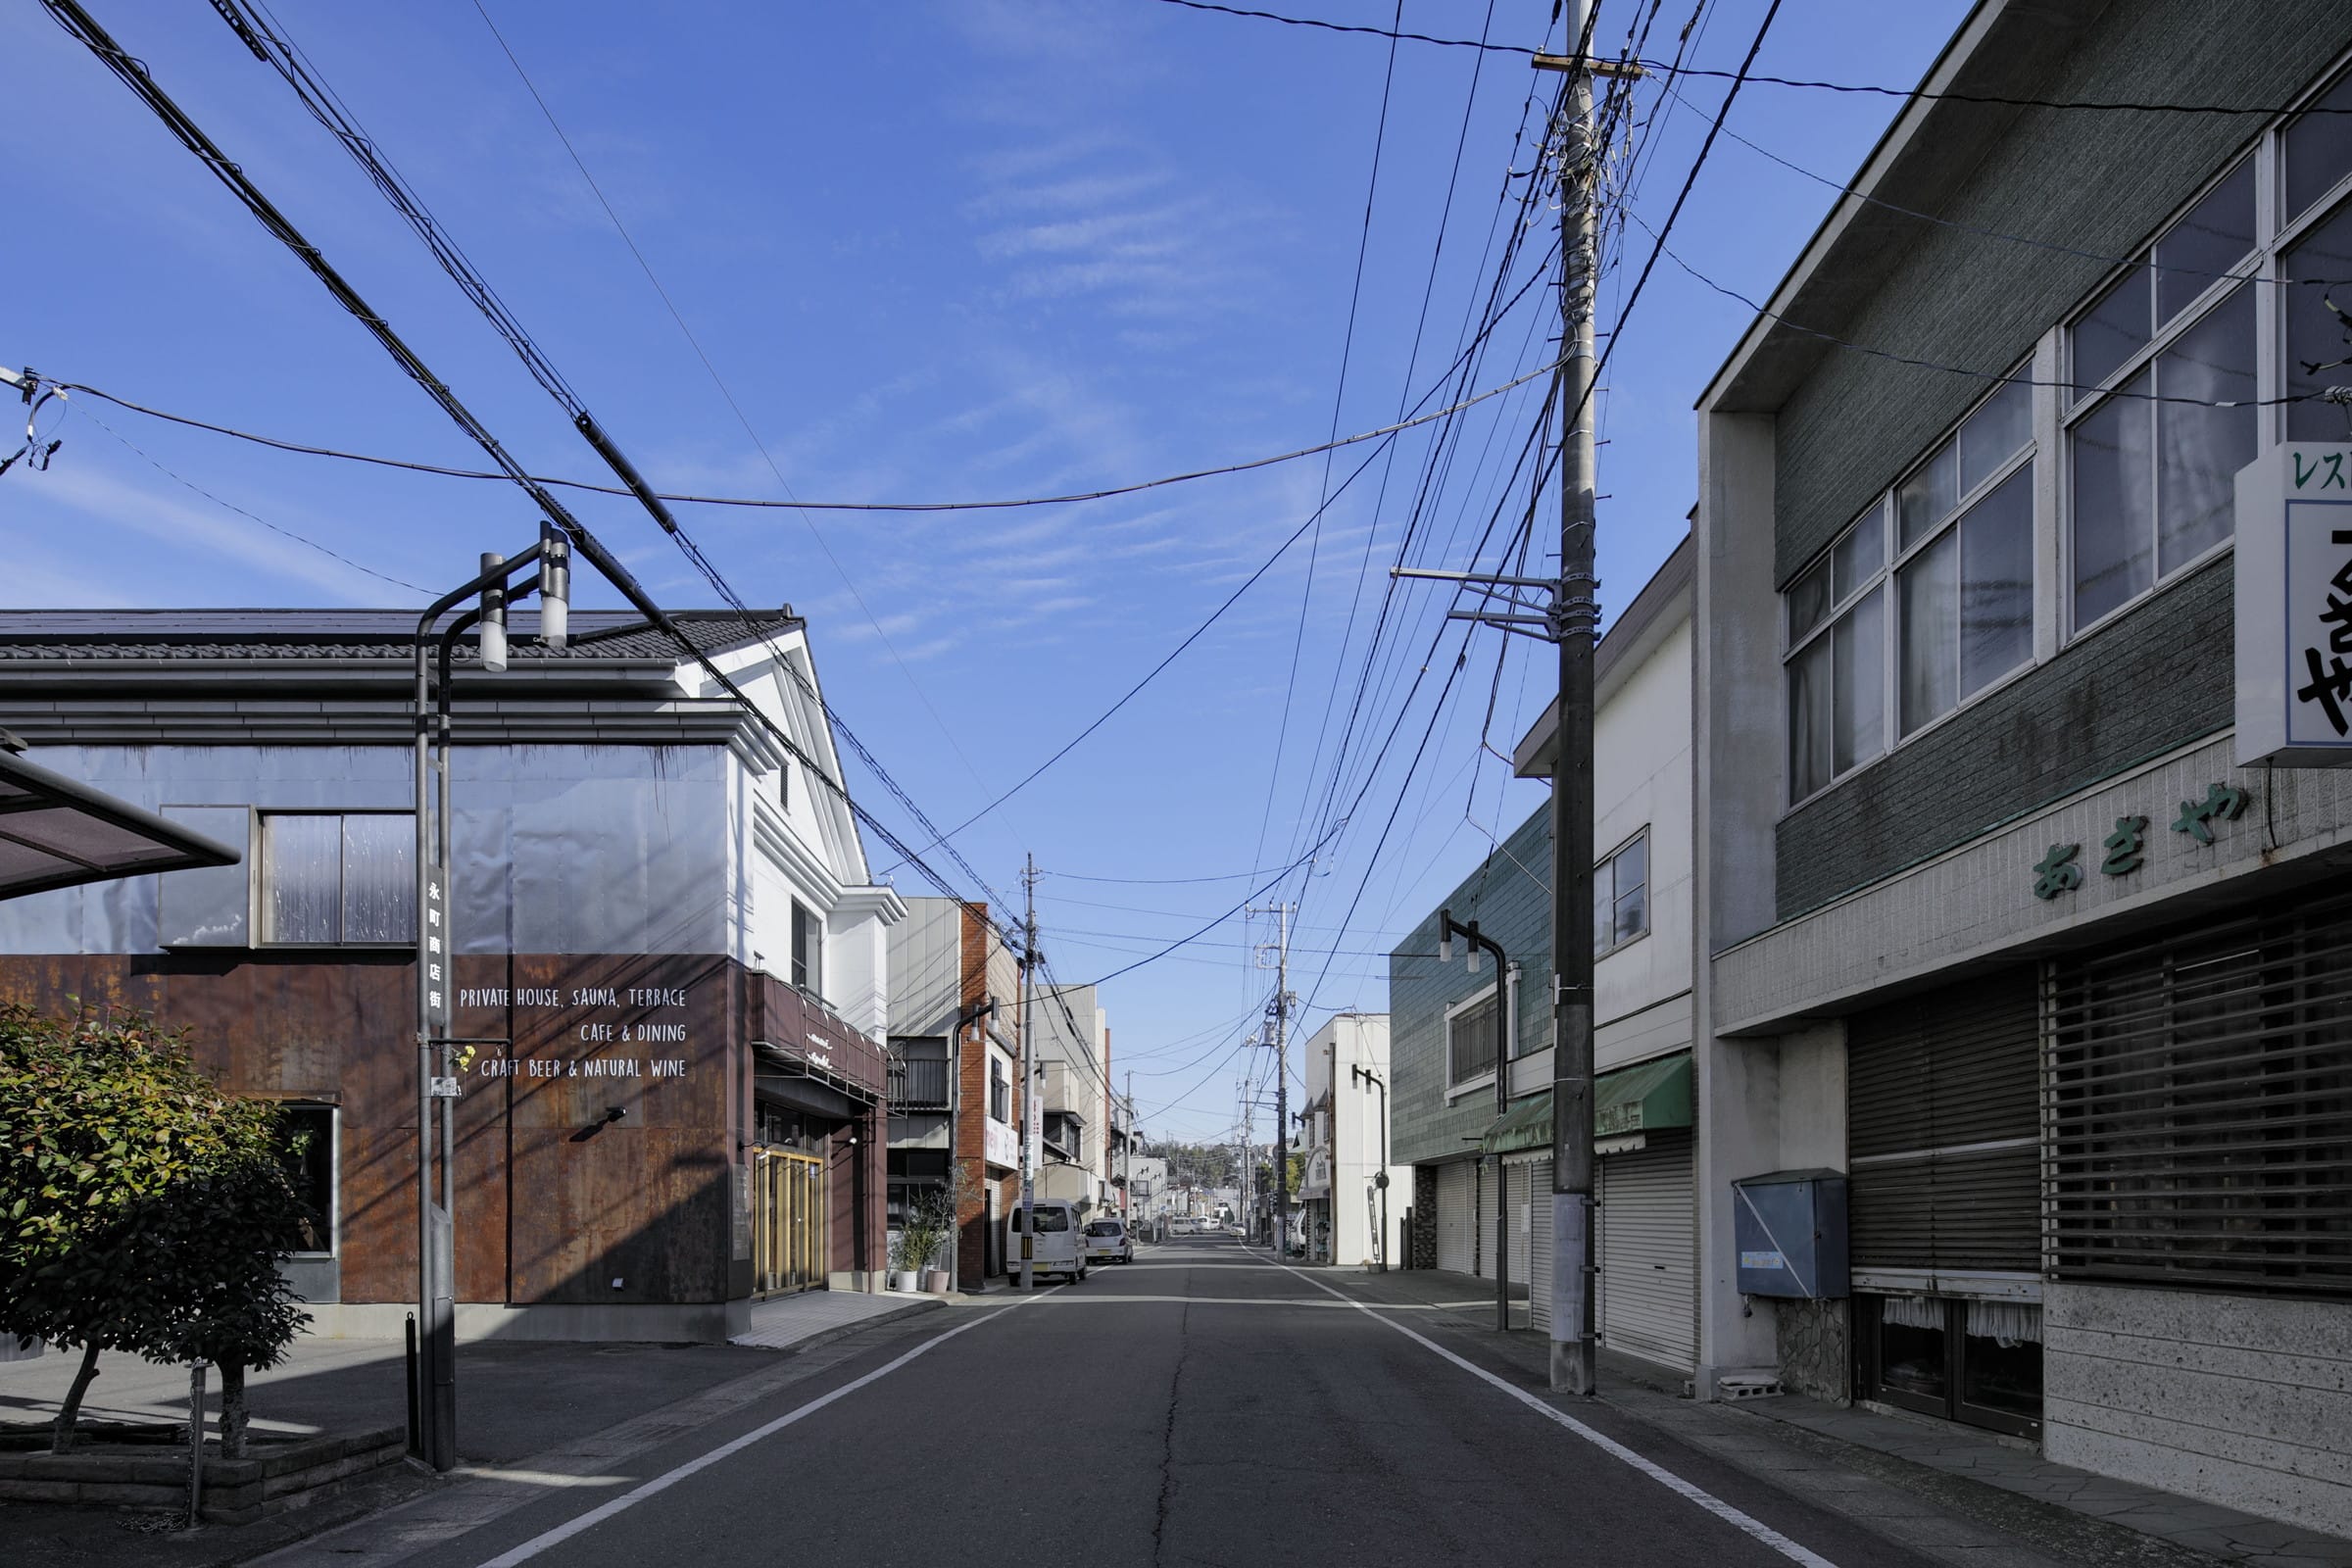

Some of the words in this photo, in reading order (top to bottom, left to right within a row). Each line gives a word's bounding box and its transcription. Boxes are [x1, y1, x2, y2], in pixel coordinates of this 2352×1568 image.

[2293, 451, 2352, 490] レス
[2033, 783, 2247, 900] あさや
[428, 881, 441, 1009] 永町商店街
[460, 988, 511, 1007] PRIVATE
[516, 988, 564, 1008] HOUSE,
[572, 988, 620, 1008] SAUNA,
[628, 988, 686, 1007] TERRACE
[580, 1024, 612, 1042] CAFE
[621, 1024, 631, 1042] &
[637, 1024, 686, 1042] DINING
[481, 1059, 519, 1077] CRAFT
[529, 1059, 561, 1077] BEER
[568, 1060, 577, 1077] &
[584, 1059, 642, 1077] NATURAL
[651, 1059, 686, 1077] WINE
